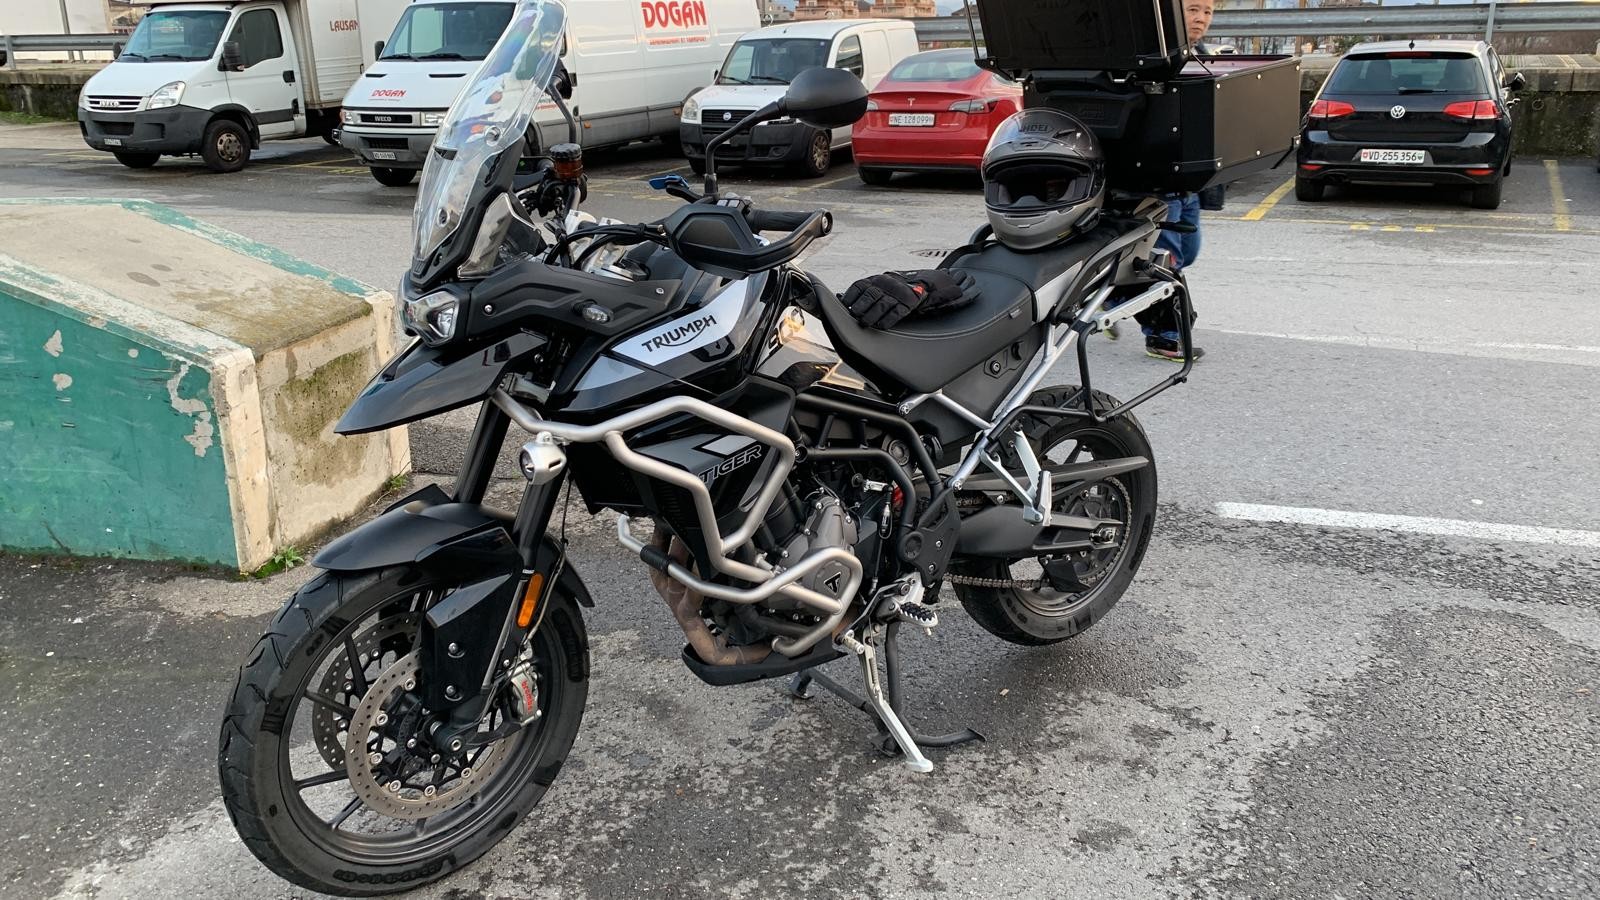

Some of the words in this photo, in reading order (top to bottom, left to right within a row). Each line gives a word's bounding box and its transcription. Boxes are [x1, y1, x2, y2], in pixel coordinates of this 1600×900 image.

[641, 1, 707, 29] DOGAN
[371, 89, 406, 97] DOGAN
[641, 314, 717, 353] TRIUMPH
[698, 444, 762, 483] TIGER
